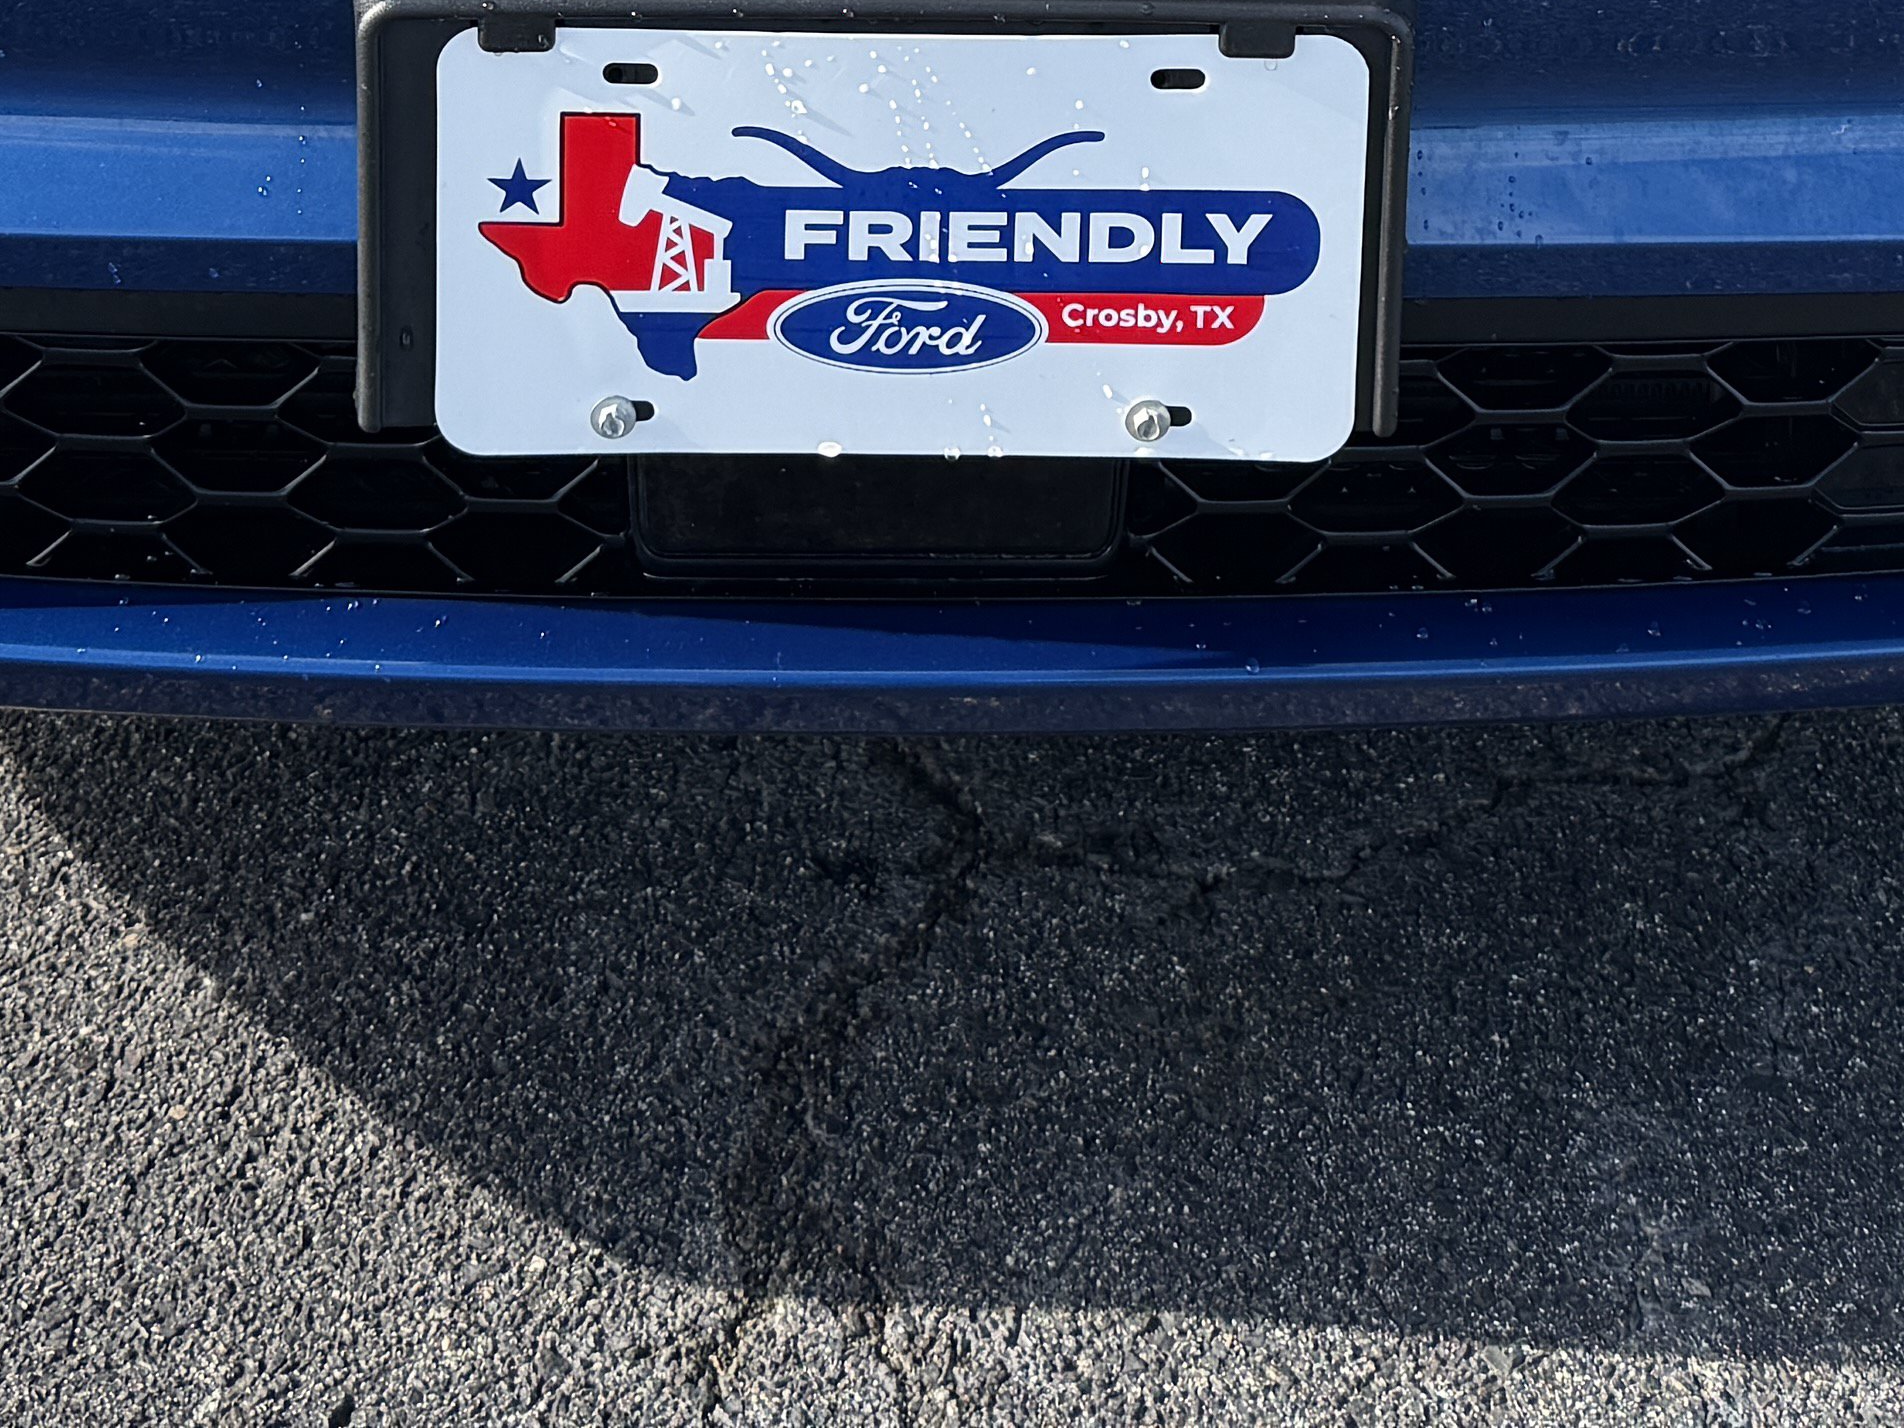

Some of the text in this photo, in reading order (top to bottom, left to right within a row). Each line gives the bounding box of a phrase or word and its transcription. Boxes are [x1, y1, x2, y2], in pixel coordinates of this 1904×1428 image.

[784, 209, 1273, 265] FRIENDLY
[829, 297, 987, 357] Ford
[1061, 303, 1235, 334] Crosby, TX
